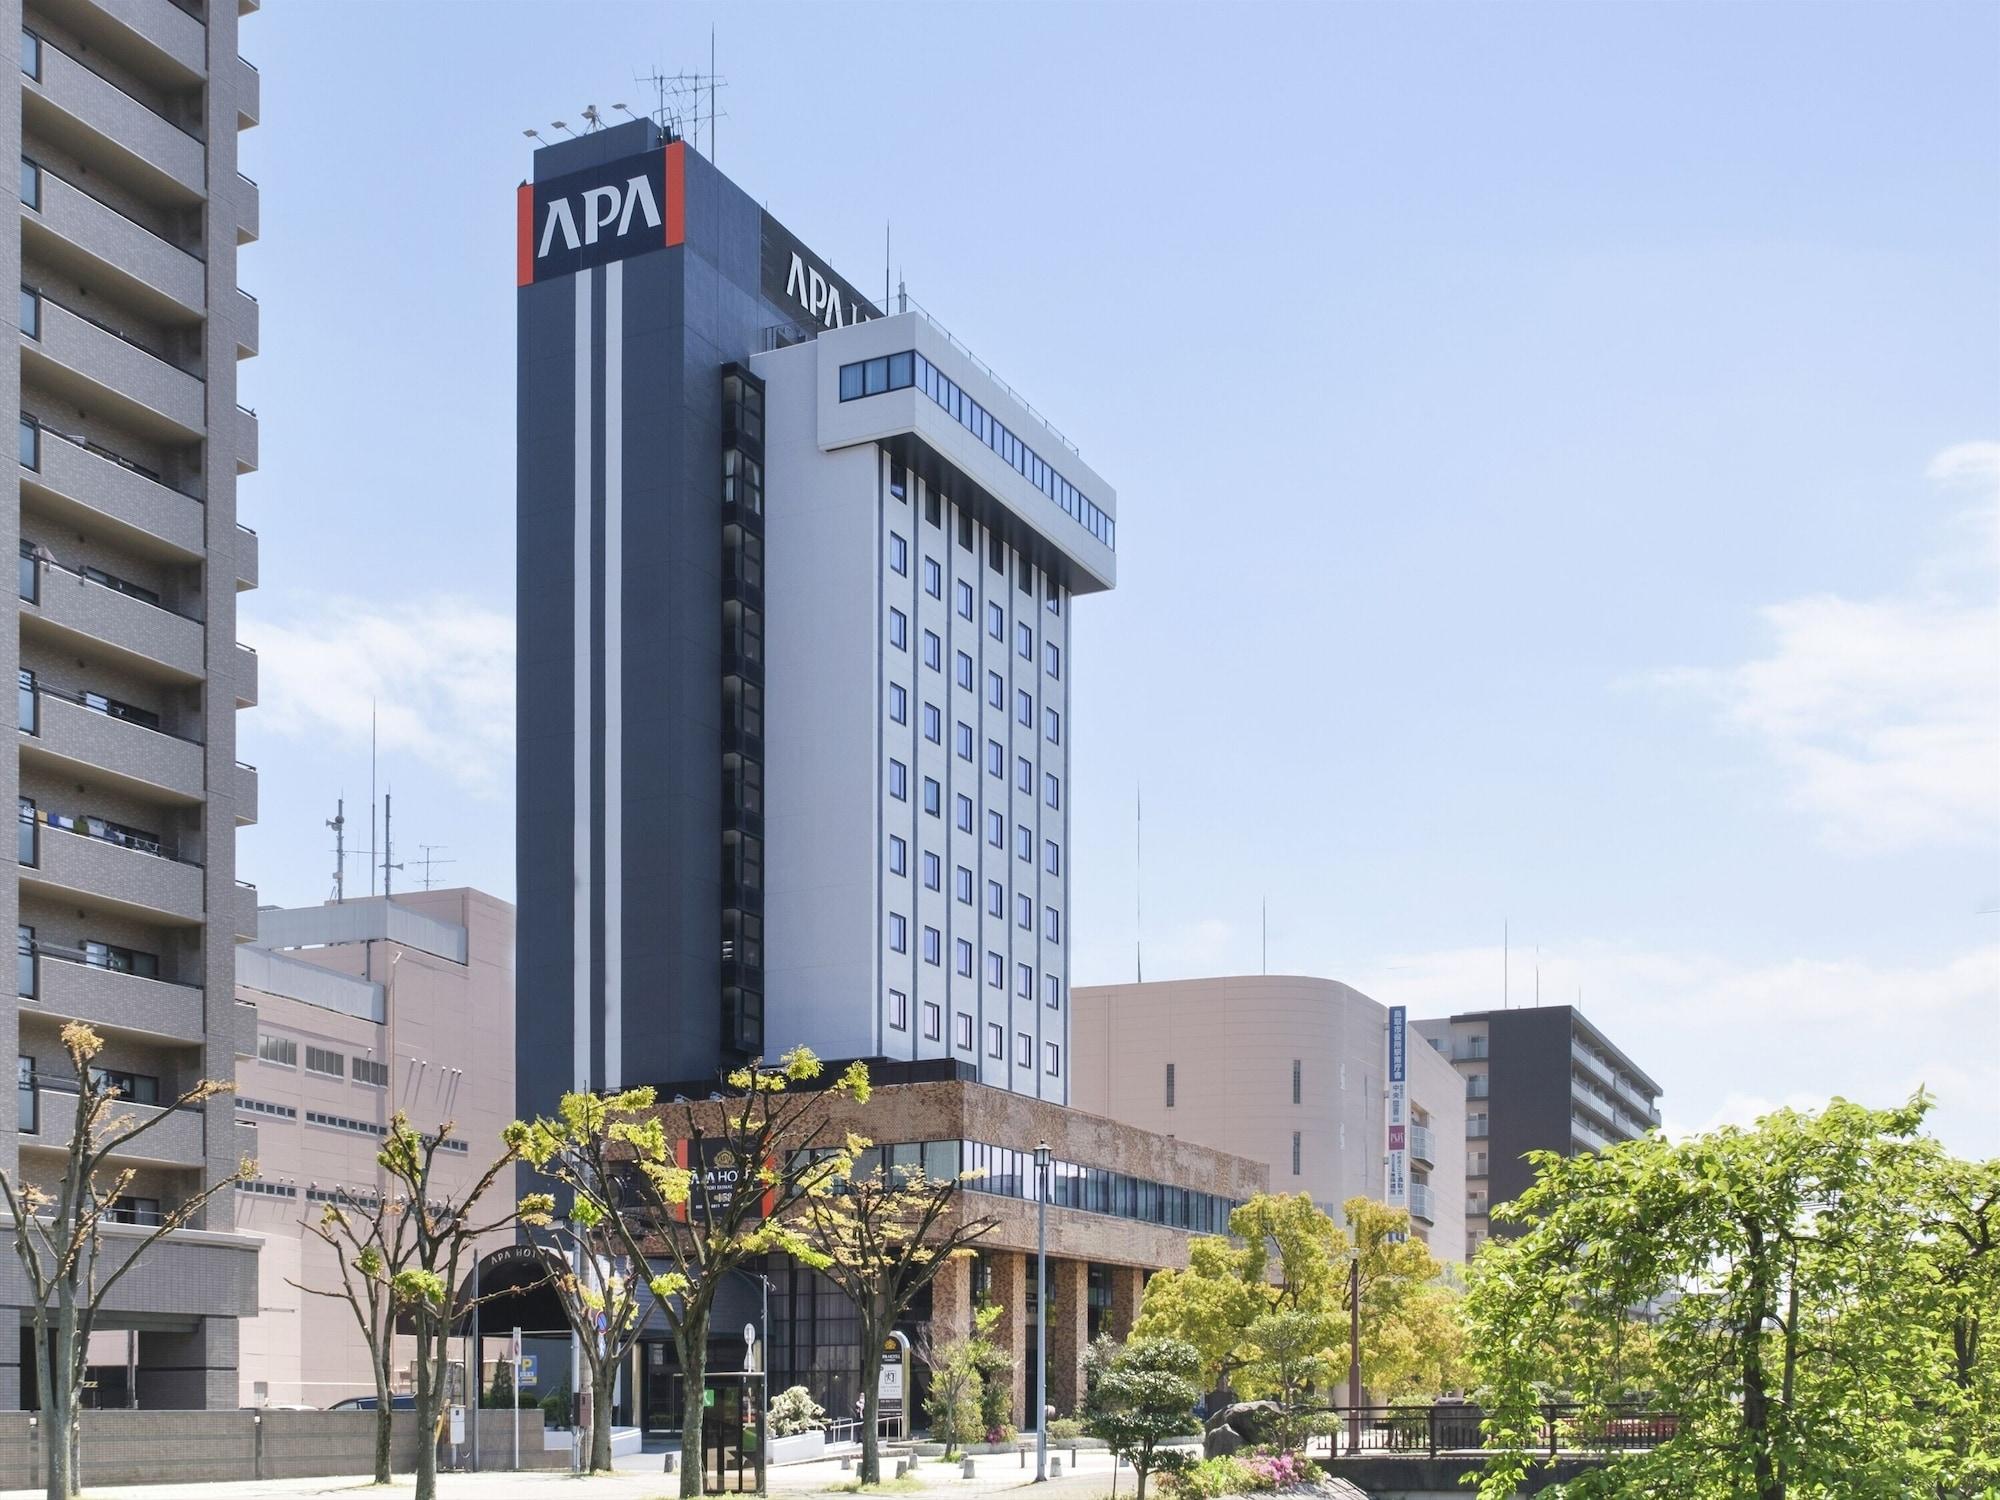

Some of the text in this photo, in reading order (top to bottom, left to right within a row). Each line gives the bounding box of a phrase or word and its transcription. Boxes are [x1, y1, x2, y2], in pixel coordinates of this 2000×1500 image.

[537, 174, 662, 258] APA
[786, 251, 844, 329] APA
[691, 1171, 715, 1185] AA
[491, 1250, 511, 1264] APA
